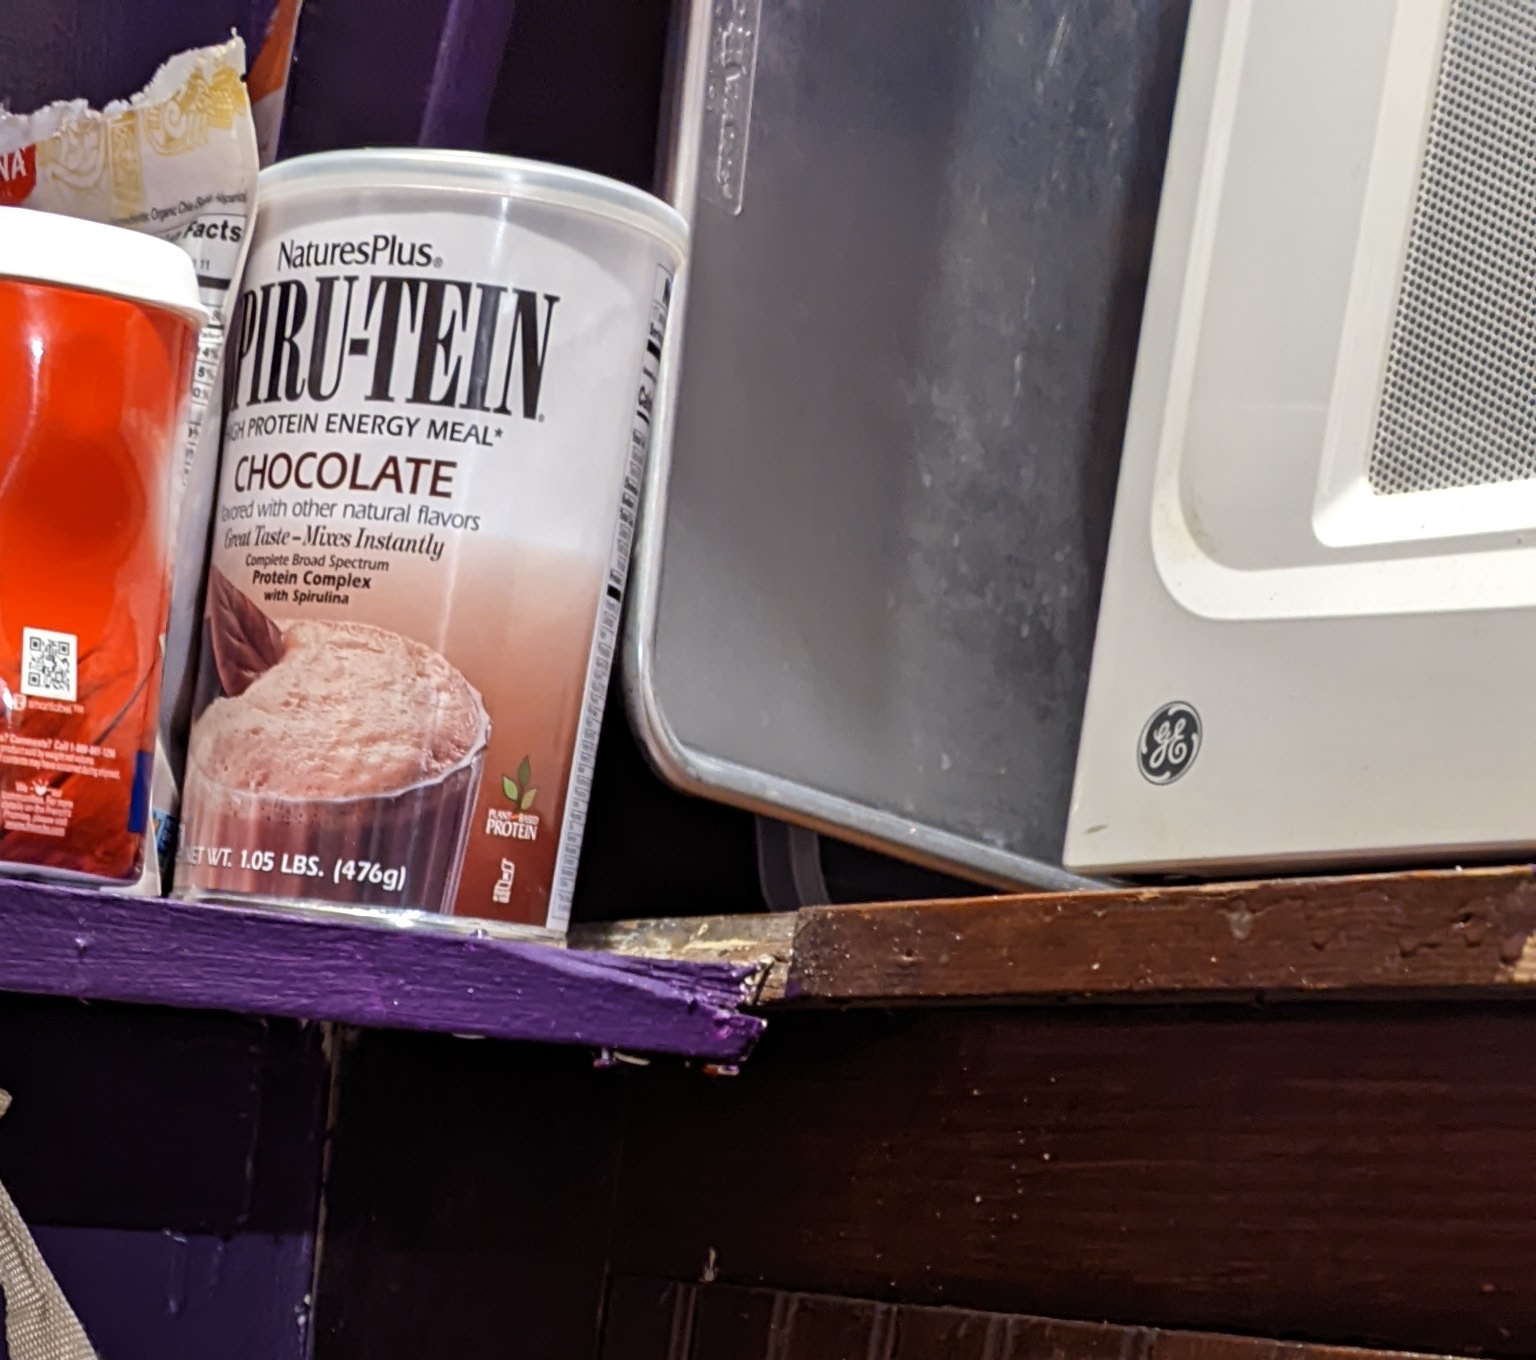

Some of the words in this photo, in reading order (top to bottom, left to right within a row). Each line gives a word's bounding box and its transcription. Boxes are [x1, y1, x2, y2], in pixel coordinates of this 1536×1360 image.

[231, 274, 561, 421] PIRU-TEIN
[247, 412, 319, 438] PROTEIN
[325, 412, 421, 438] ENERGY
[233, 451, 459, 500] CHOCOLATE
[256, 497, 289, 518] with
[291, 499, 337, 520] other
[342, 501, 413, 525] natural
[416, 503, 482, 532] flavors
[353, 526, 446, 562] Instantly
[245, 552, 291, 568] Complete
[292, 553, 327, 568] Broad
[328, 553, 391, 573] Spectrum
[252, 569, 298, 587] Protein
[302, 569, 372, 591] Complex
[263, 588, 290, 603] with
[291, 589, 350, 606] Spirulina
[485, 817, 539, 842] PROTEIN
[206, 846, 234, 868] WT.
[239, 848, 276, 873] 1.05
[280, 852, 326, 878] LBS.
[332, 857, 408, 892] (476g)
